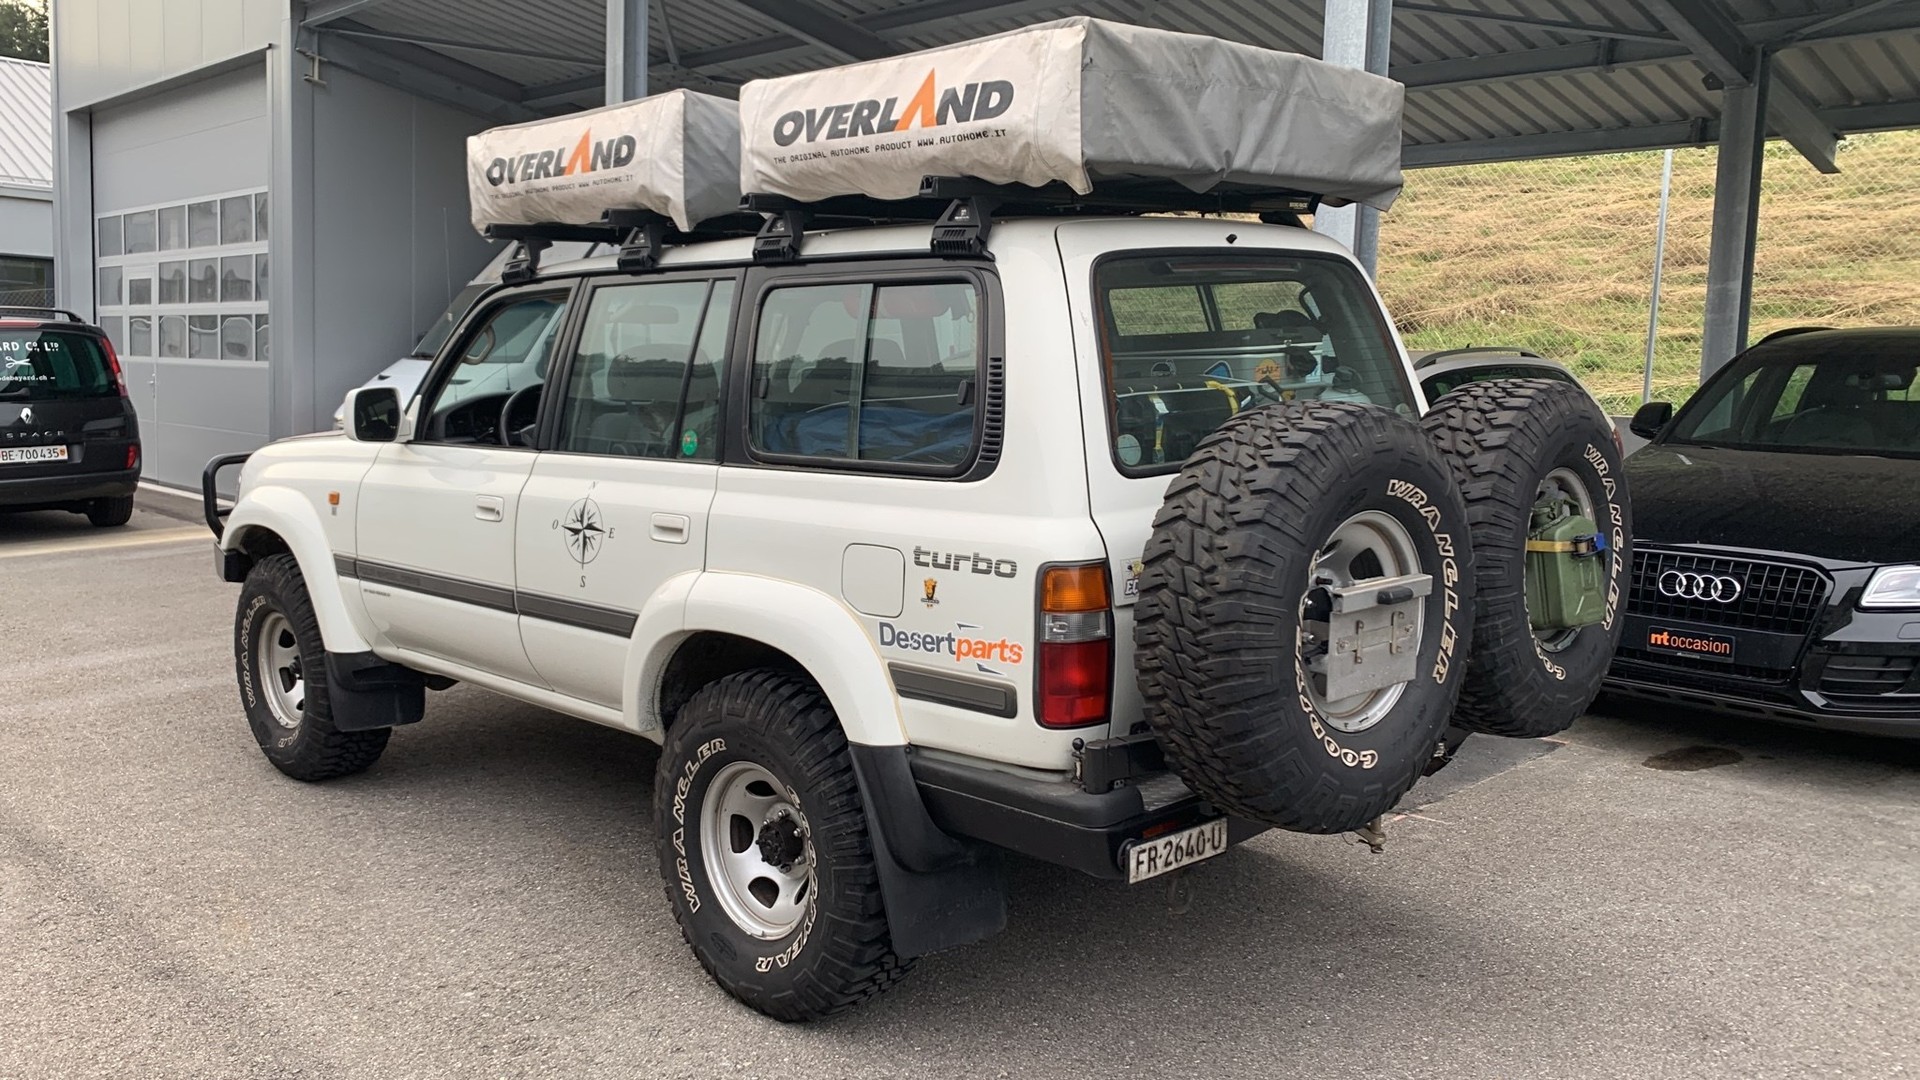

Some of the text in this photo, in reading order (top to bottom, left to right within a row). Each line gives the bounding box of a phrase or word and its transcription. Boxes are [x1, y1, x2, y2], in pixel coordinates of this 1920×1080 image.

[773, 67, 1015, 147] OVERLAND
[485, 127, 637, 187] OVERLAND
[773, 156, 787, 165] THE
[789, 151, 827, 163] ORIGINAL
[830, 146, 870, 157] AUTOHOME
[874, 140, 912, 152] PRODUCT
[6, 430, 65, 439] SPACE
[608, 527, 616, 539] E
[1583, 443, 1624, 631] WRANGLER
[579, 575, 587, 588] S
[912, 545, 1018, 579] turbo
[1386, 478, 1459, 685] WRANGLER
[878, 620, 1025, 665] Desertparts
[1670, 636, 1730, 655] occasion
[672, 737, 727, 914] WRANGLER
